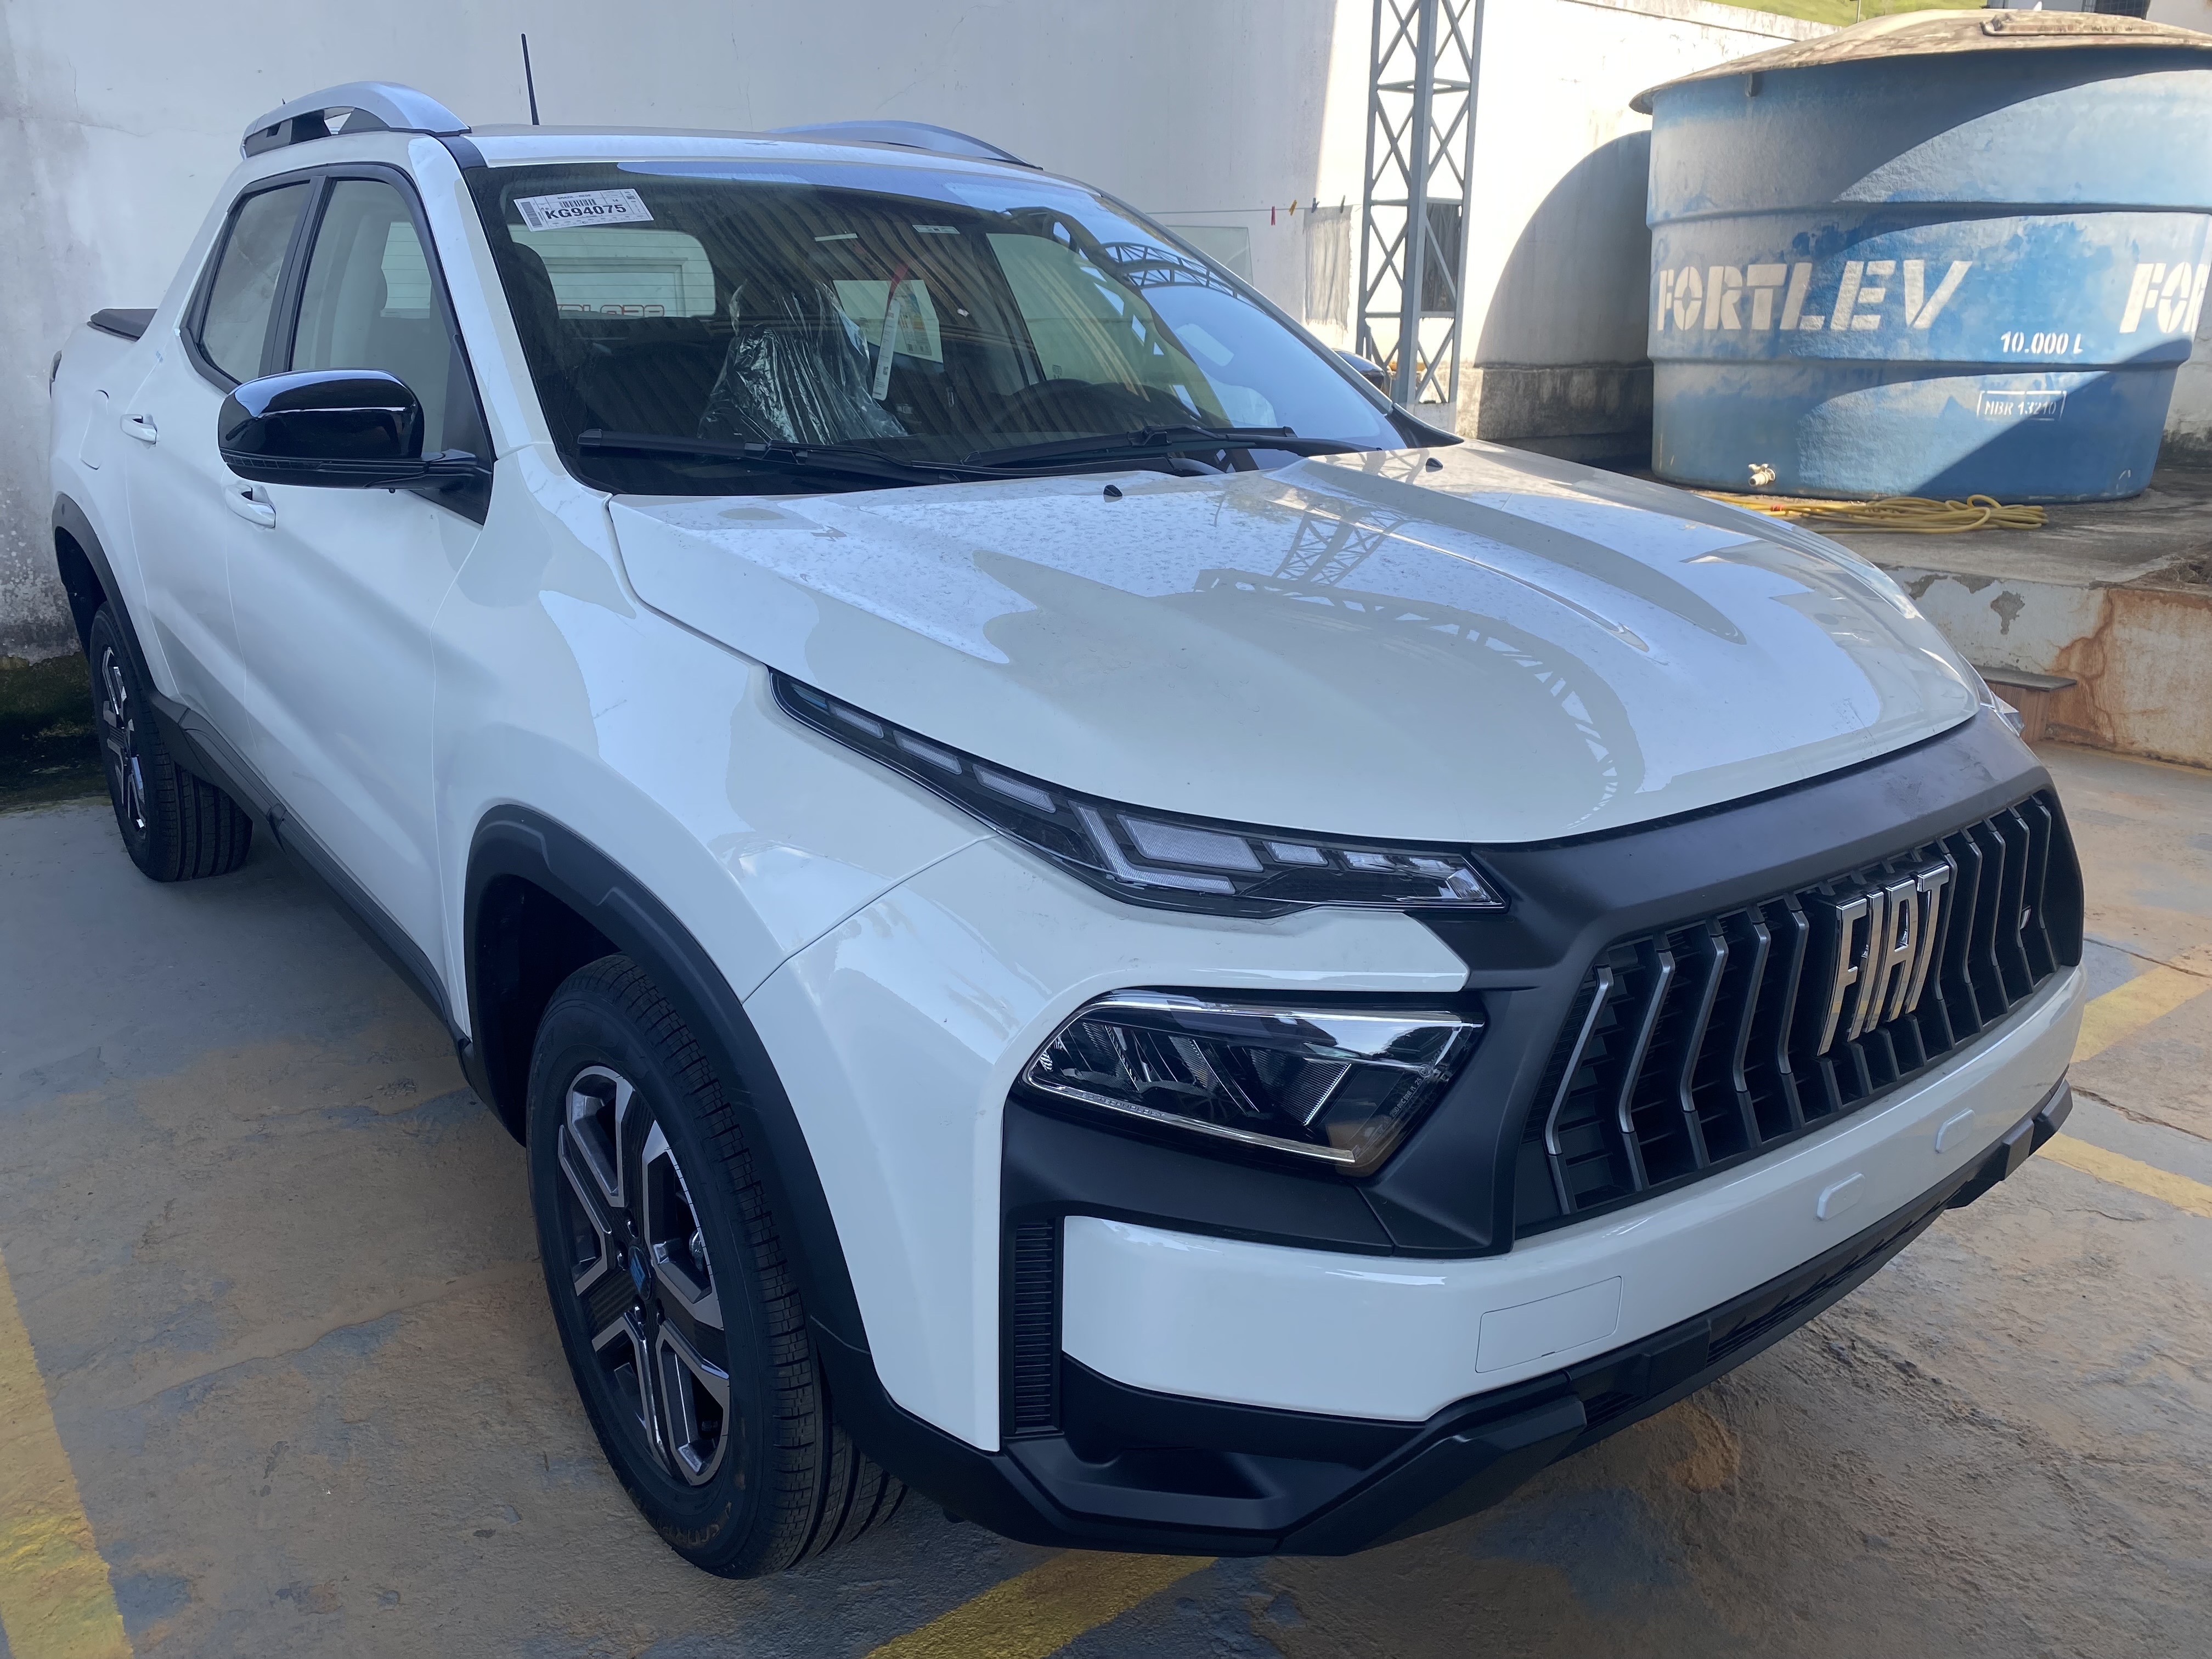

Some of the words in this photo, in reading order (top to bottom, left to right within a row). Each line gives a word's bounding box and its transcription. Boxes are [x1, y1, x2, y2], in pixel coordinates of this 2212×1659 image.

[544, 205, 627, 219] KG94075
[1657, 259, 1973, 331] FORTLEV
[2000, 331, 2069, 354] 10.000
[2073, 333, 2084, 354] L
[1984, 400, 2014, 415] NBR
[1817, 864, 1949, 1056] FIAT
[1098, 1097, 1165, 1117] TECHNOLOGY
